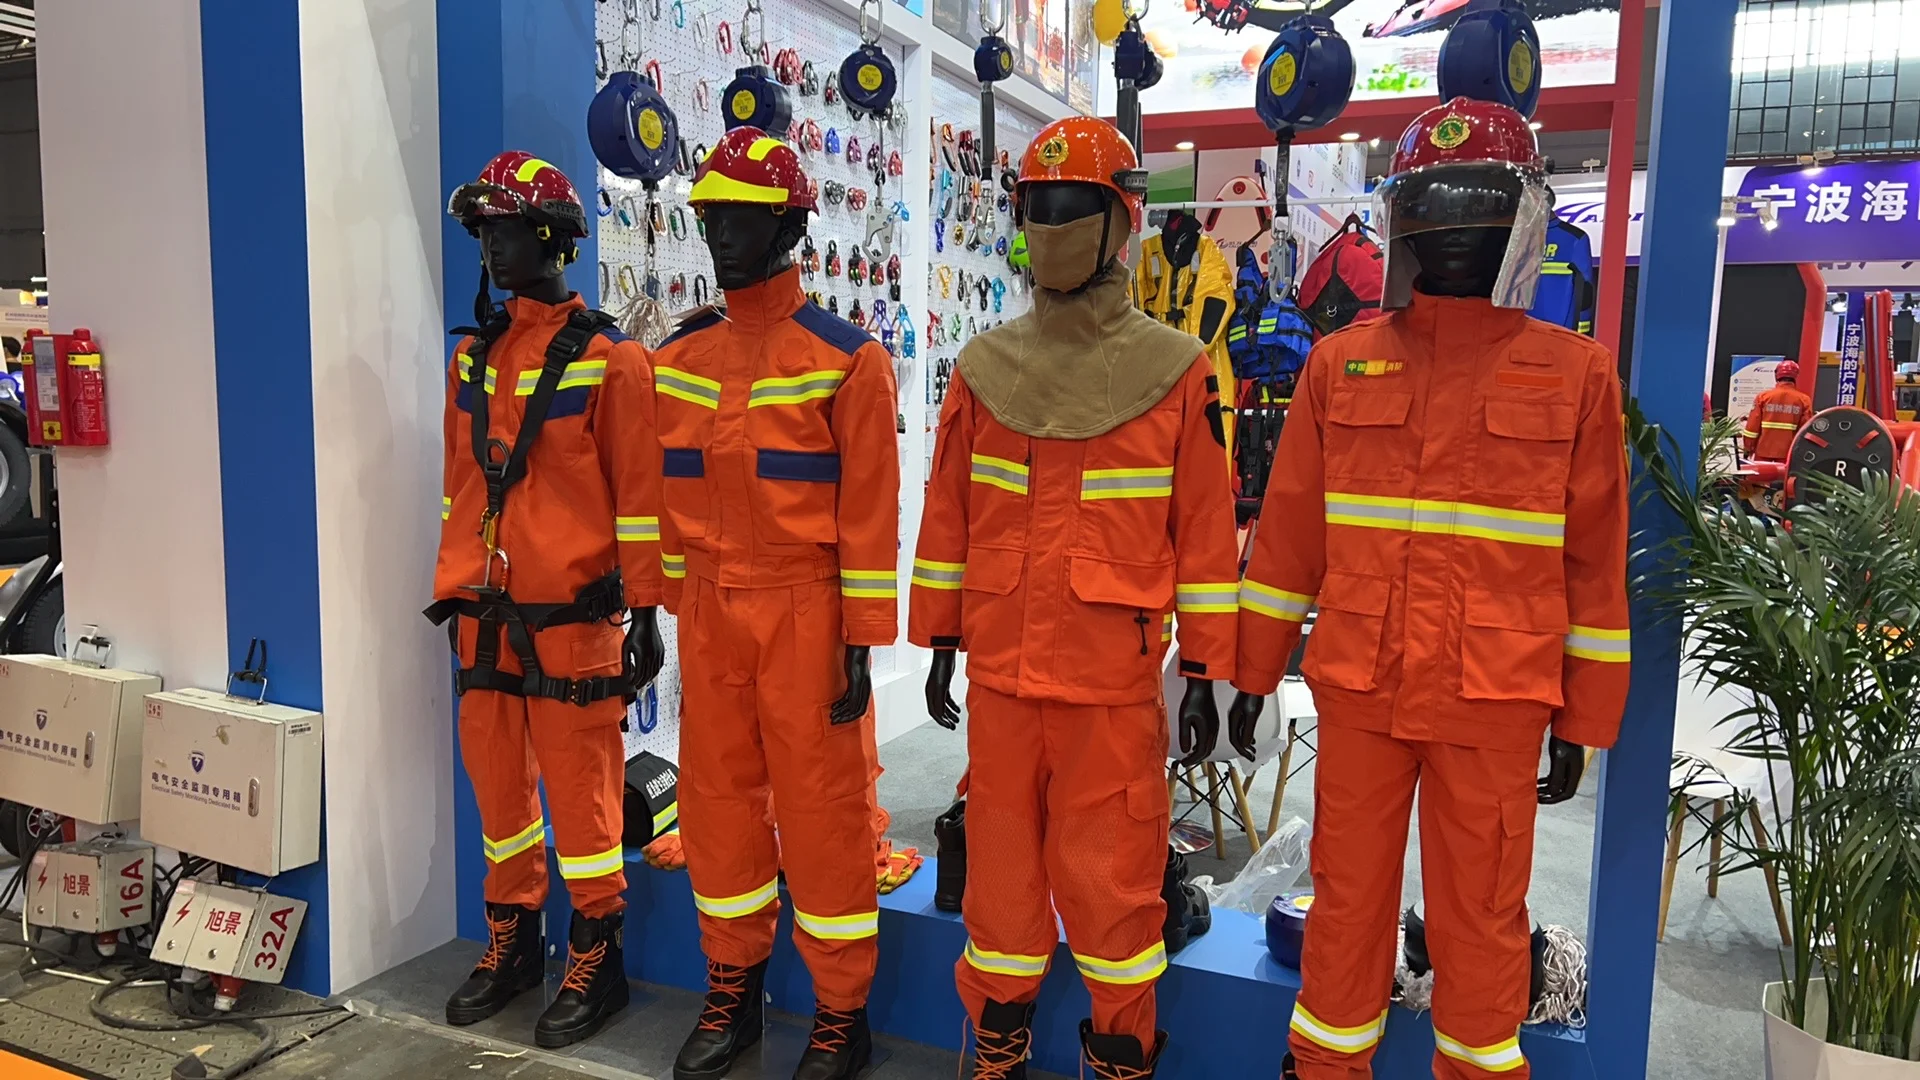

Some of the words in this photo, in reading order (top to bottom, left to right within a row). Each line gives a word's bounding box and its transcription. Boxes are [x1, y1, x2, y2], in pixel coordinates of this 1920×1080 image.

[1751, 181, 1920, 224] 宁波海
[1840, 323, 1861, 405] 宁波海的户外用
[1835, 460, 1847, 477] R
[151, 771, 241, 803] 电气安全监测专用箱
[151, 783, 170, 793] Electrical
[171, 788, 184, 798] Safety
[185, 792, 208, 804] Monitoring
[208, 798, 231, 809] Dedicated
[231, 803, 241, 811] Box
[63, 873, 90, 896] 旭景
[120, 858, 144, 918] 16A
[204, 907, 242, 936] 旭景
[254, 907, 295, 970] 32A
